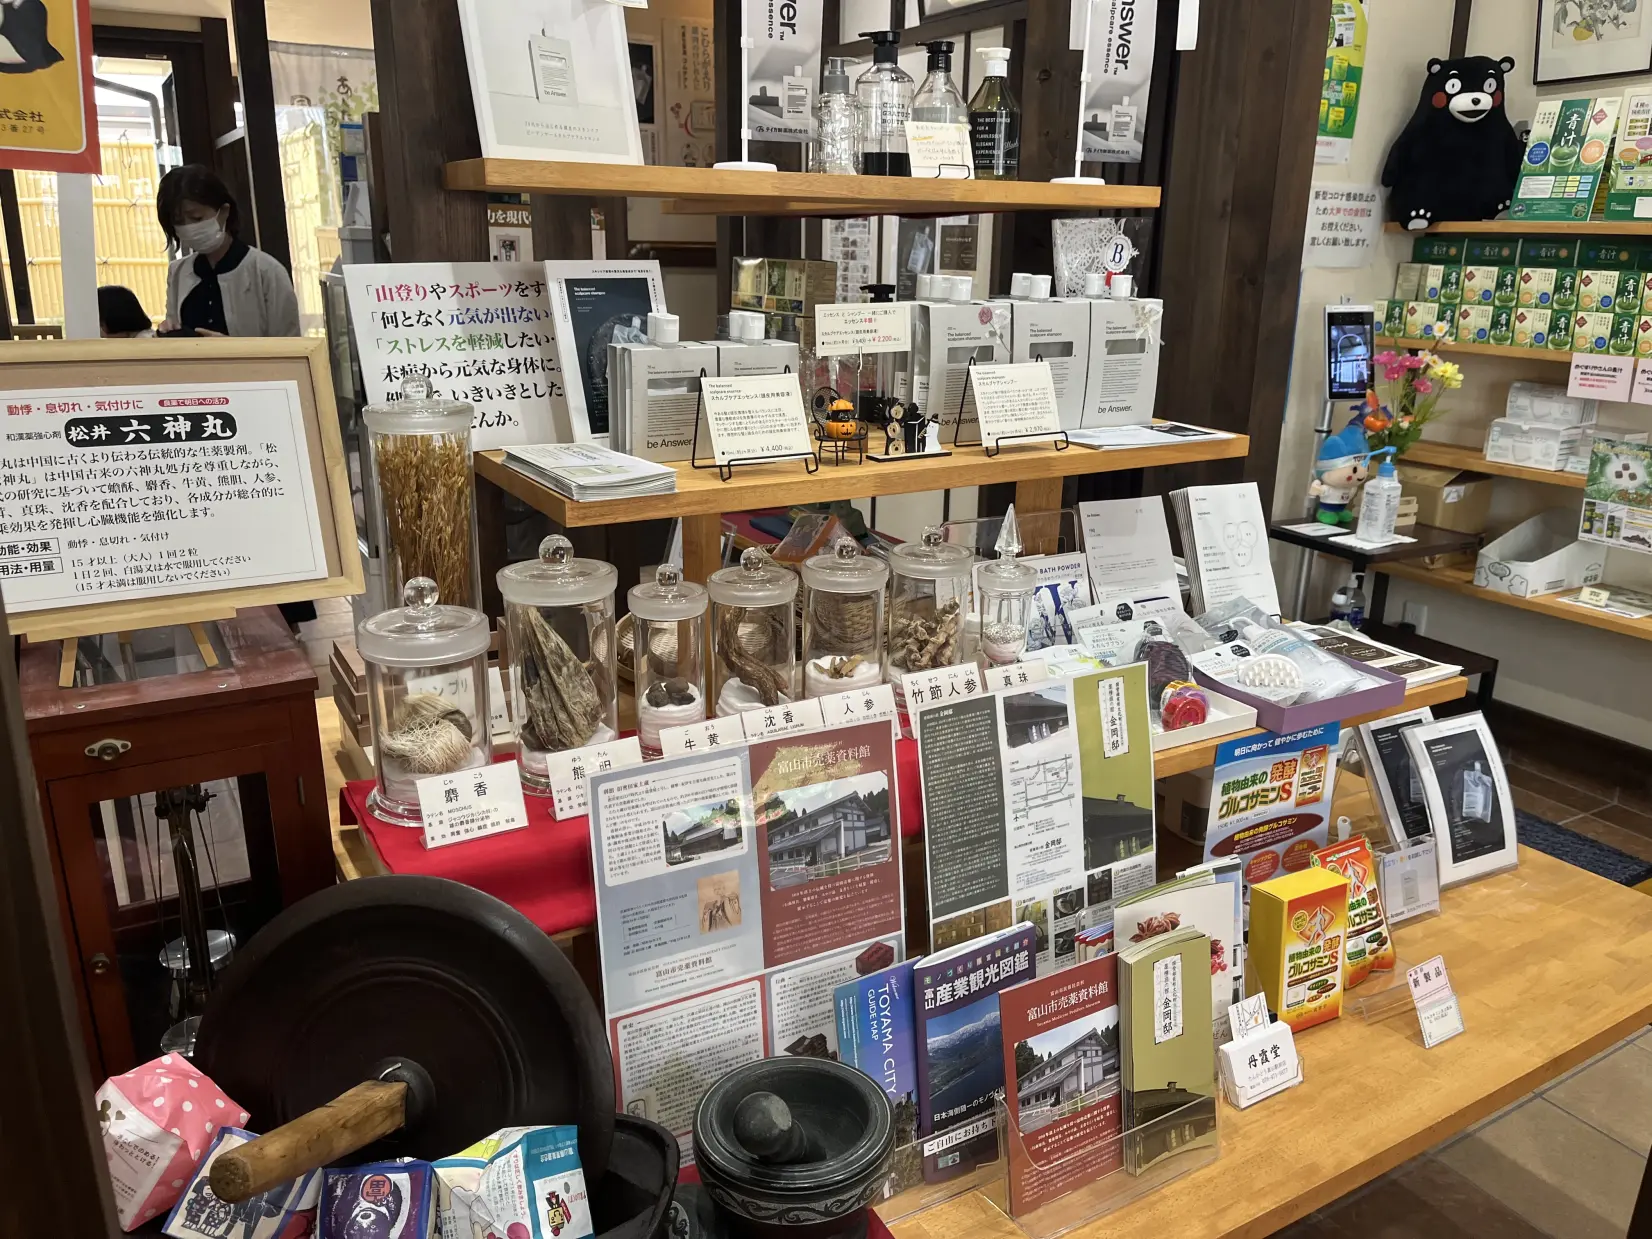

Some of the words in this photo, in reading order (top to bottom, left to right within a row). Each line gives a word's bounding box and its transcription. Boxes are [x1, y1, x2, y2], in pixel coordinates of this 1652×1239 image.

[780, 0, 797, 35] er
[1561, 113, 1581, 147] 青汁
[7, 399, 144, 416] 動悸・息切れ・気付けに
[1098, 405, 1107, 414] be
[68, 424, 111, 442] 松井
[120, 414, 233, 443] 六神丸
[647, 440, 659, 449] be
[0, 459, 280, 486] 神丸」は中国古来の六神丸処方を尊重しながら、
[67, 532, 169, 549] 動悸・息切れ・気付け
[1040, 566, 1056, 574] BATH
[1058, 562, 1081, 571] POWDER
[912, 678, 977, 704] 竹節人参
[1003, 672, 1029, 687] 真珠
[764, 711, 794, 728] 沈香
[844, 698, 874, 715] 人参
[684, 733, 720, 750] 牛黄
[1110, 716, 1120, 750] 金岡邸
[778, 745, 871, 774] 富山市売薬資料館
[1234, 739, 1274, 757] 明日に向かって
[1221, 771, 1268, 796] 植物由来の
[1270, 758, 1298, 784] 発酵
[448, 805, 472, 814] MOSCHUS
[1218, 782, 1293, 820] グルコサミンS
[936, 950, 1029, 1007] 産業観光図鑑
[868, 989, 877, 1020] GUIDE
[1026, 981, 1109, 1022] 富山市売薬資料館
[878, 983, 894, 1055] TOYAMA
[1162, 997, 1173, 1035] 金岡邸
[870, 1021, 879, 1041] MAP
[884, 1058, 897, 1094] CITY
